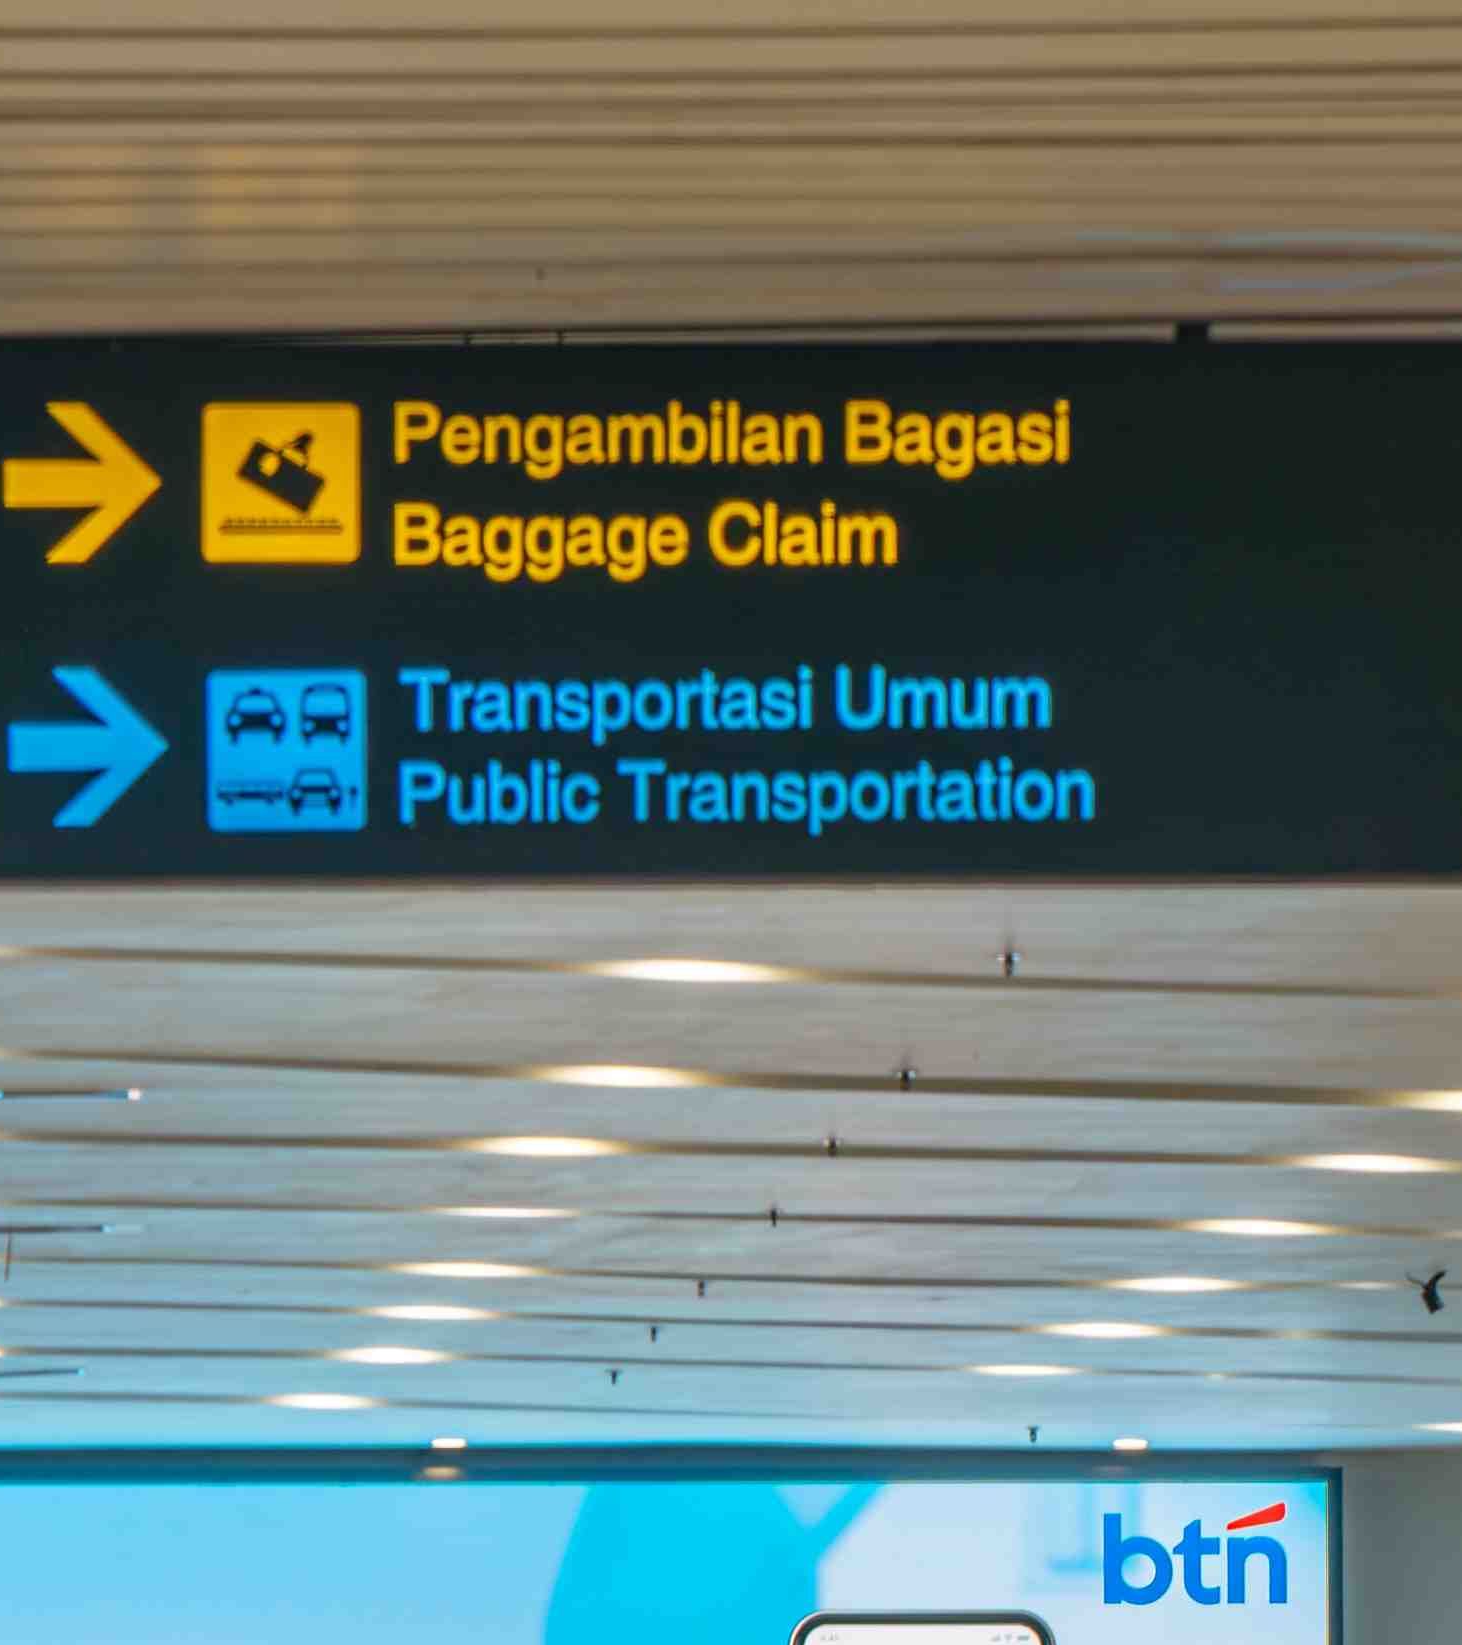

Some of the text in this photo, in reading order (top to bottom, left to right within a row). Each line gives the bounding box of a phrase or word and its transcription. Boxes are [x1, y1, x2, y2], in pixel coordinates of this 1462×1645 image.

[394, 400, 1072, 478] Pengambilan Bagasi
[393, 500, 899, 580] Baggage Claim
[399, 666, 1052, 746] Transportasi Umum
[398, 758, 1097, 836] Public Transportation
